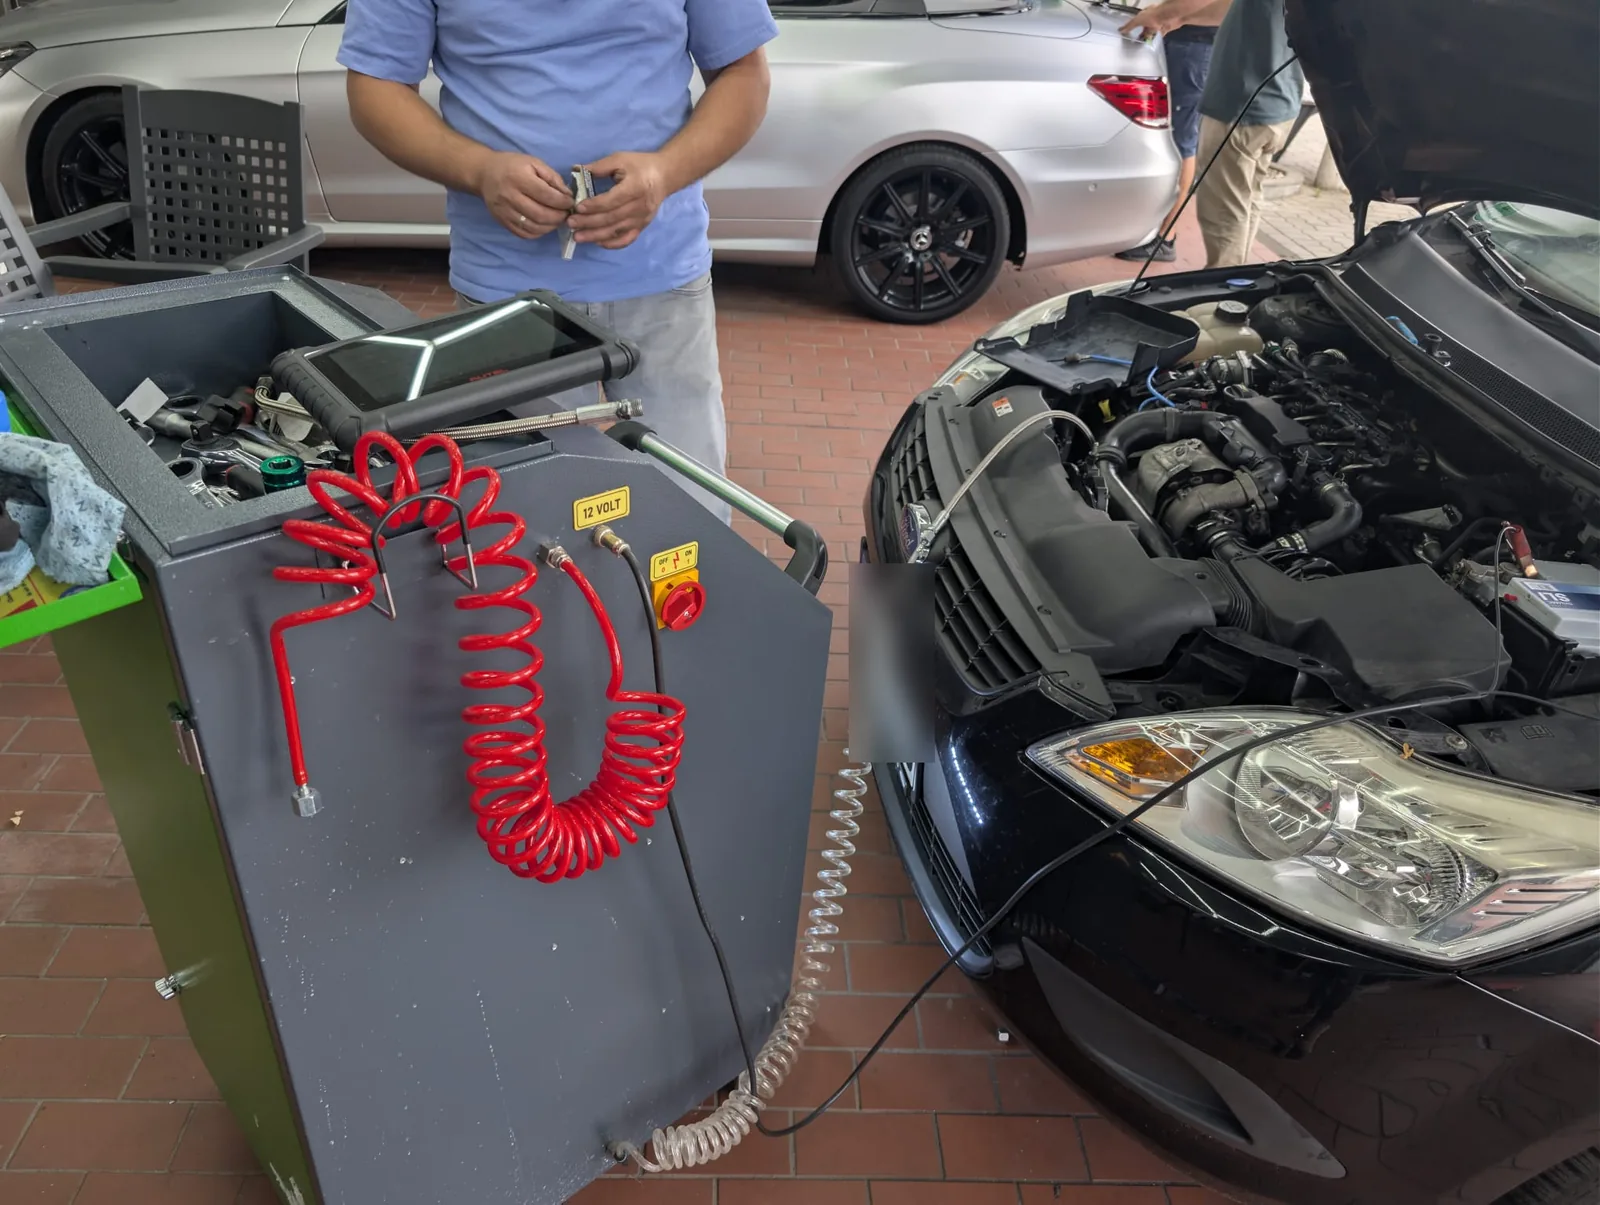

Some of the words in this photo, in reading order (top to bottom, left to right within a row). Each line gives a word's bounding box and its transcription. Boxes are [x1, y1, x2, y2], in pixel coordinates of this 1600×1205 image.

[583, 506, 594, 519] 12
[596, 498, 621, 515] VOLT
[659, 557, 668, 565] OFF
[1538, 591, 1571, 603] SLI
